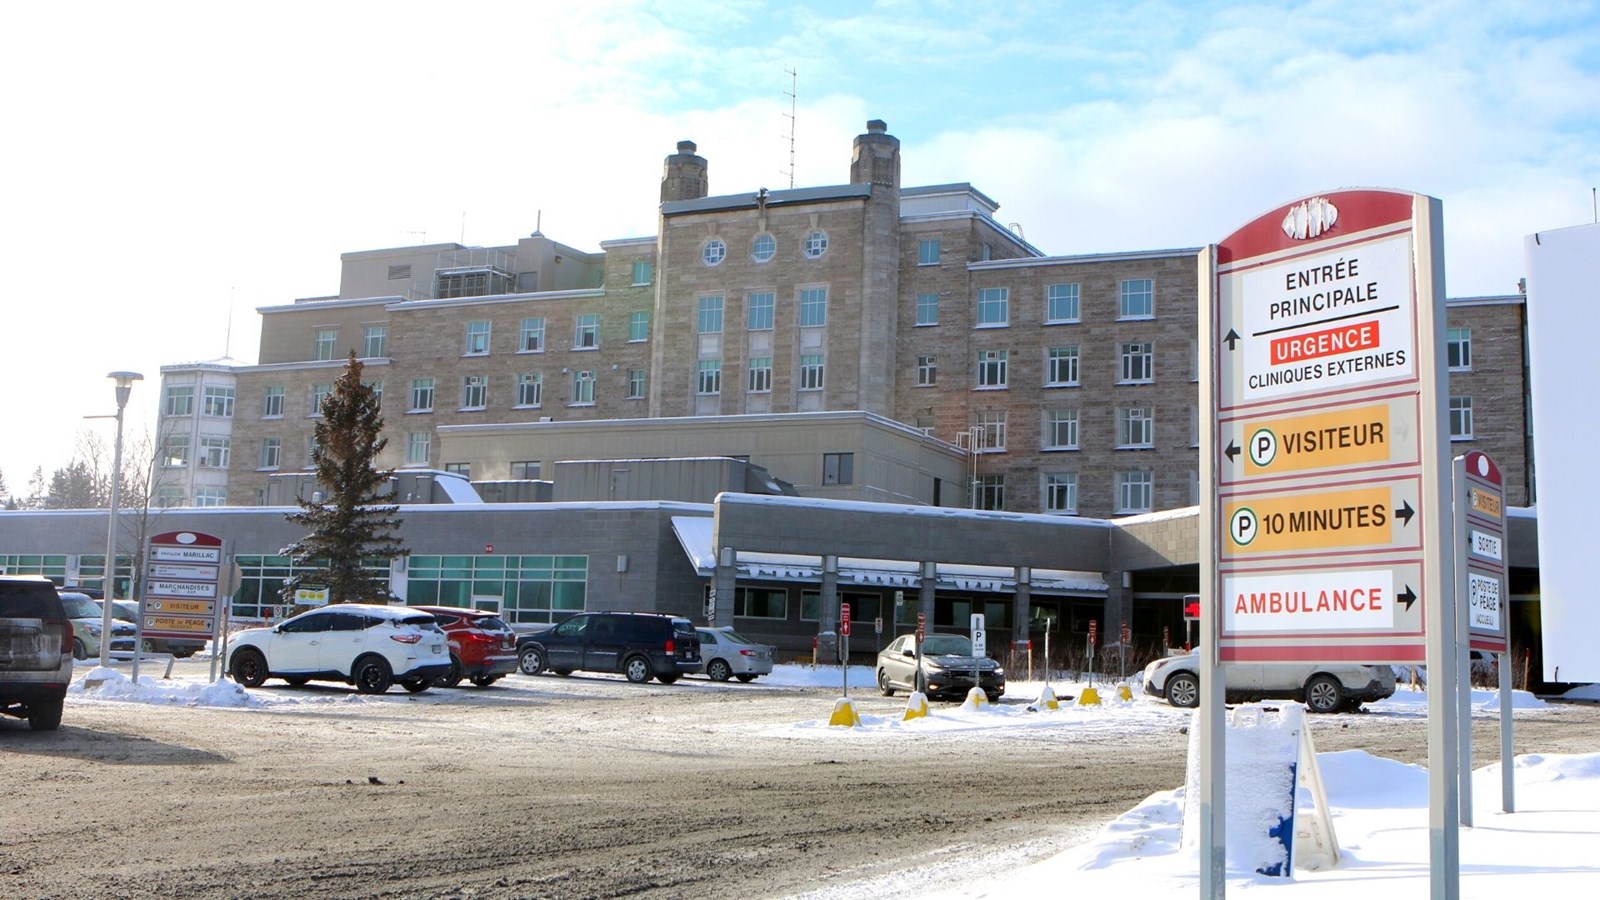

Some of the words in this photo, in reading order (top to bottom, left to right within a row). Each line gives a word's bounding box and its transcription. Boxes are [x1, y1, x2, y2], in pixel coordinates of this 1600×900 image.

[1286, 258, 1359, 291] ENTRÉE
[1270, 282, 1378, 320] PRINCIPALE
[1277, 326, 1373, 361] URGENCE
[1248, 364, 1323, 389] CLINIQUES
[1327, 350, 1406, 377] EXTERNES
[1258, 436, 1271, 459] P
[1282, 422, 1384, 455] VISITEUR
[1477, 493, 1500, 514] VISITEUR
[1239, 515, 1251, 538] P
[1262, 513, 1285, 535] 10
[1289, 504, 1386, 533] MINUTES
[183, 551, 214, 559] MARILLAC
[1478, 536, 1497, 555] SORTIE
[1234, 587, 1383, 615] AMBULANCE
[976, 631, 982, 642] P
